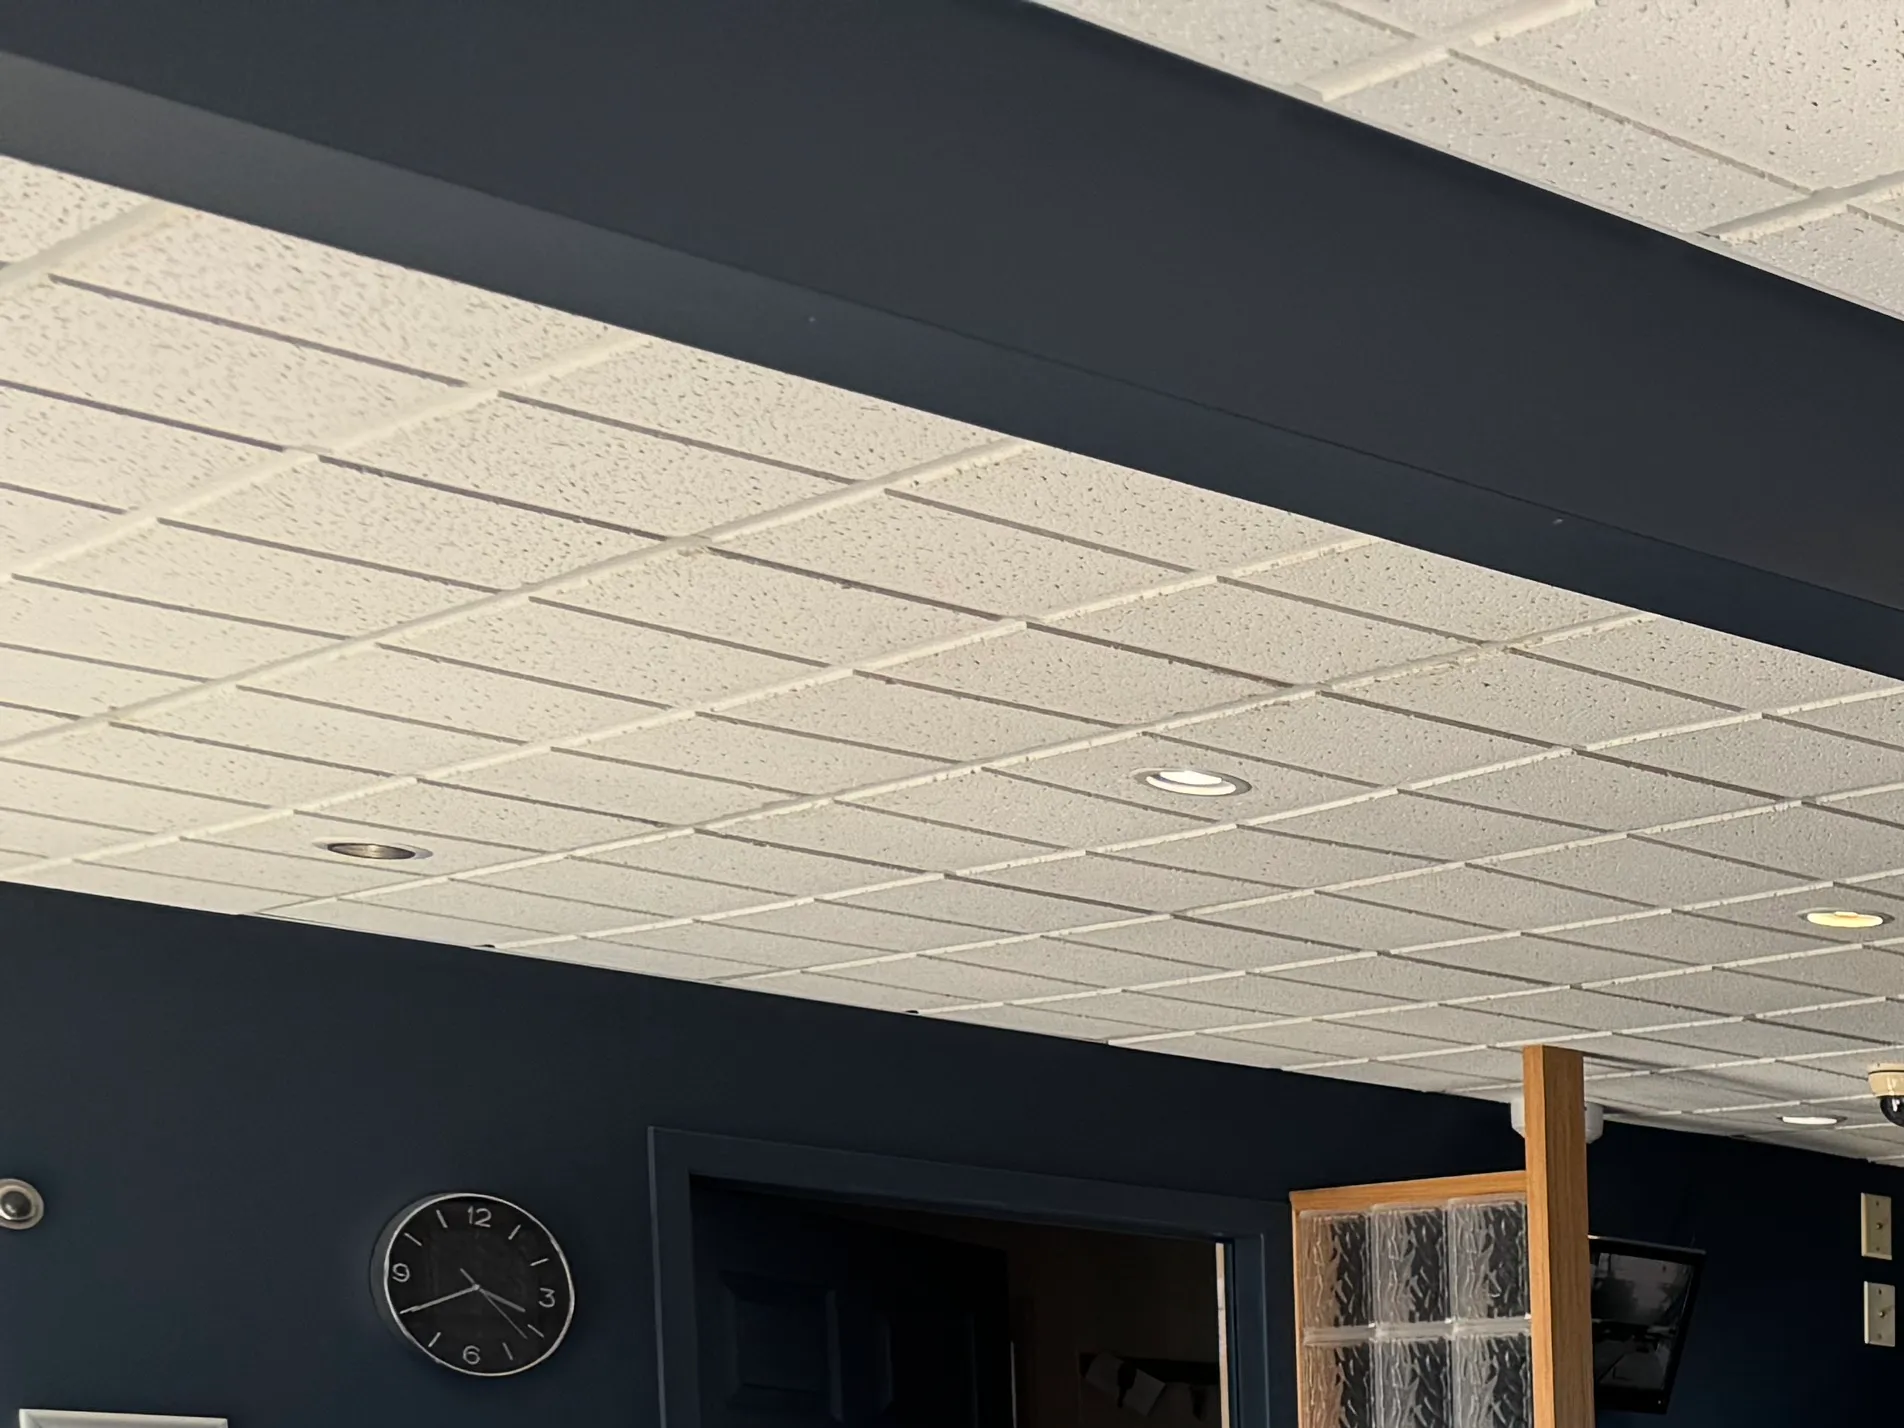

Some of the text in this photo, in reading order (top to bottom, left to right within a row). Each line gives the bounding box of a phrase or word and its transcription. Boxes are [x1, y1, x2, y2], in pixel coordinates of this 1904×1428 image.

[468, 1206, 492, 1228] 12
[392, 1262, 411, 1283] 9
[538, 1287, 556, 1308] 3
[462, 1344, 481, 1366] 6
